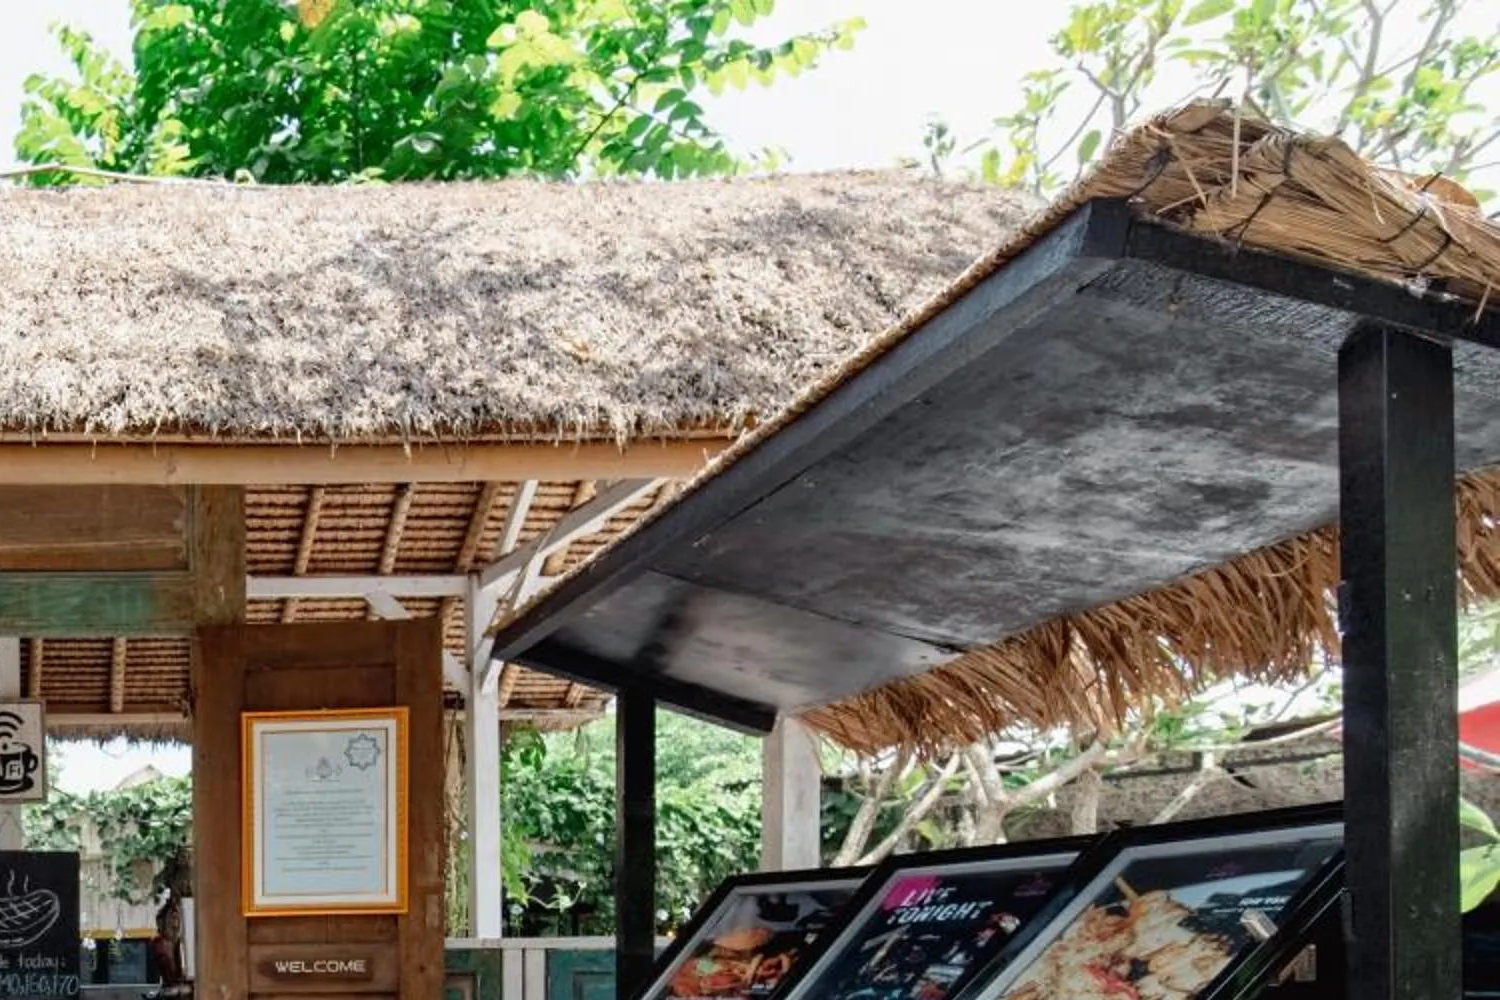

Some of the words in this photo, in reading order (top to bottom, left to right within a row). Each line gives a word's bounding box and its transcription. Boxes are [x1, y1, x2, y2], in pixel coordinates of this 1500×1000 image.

[900, 886, 957, 908] LIVE
[886, 900, 994, 926] TONIGHT
[275, 959, 366, 974] WELCOME
